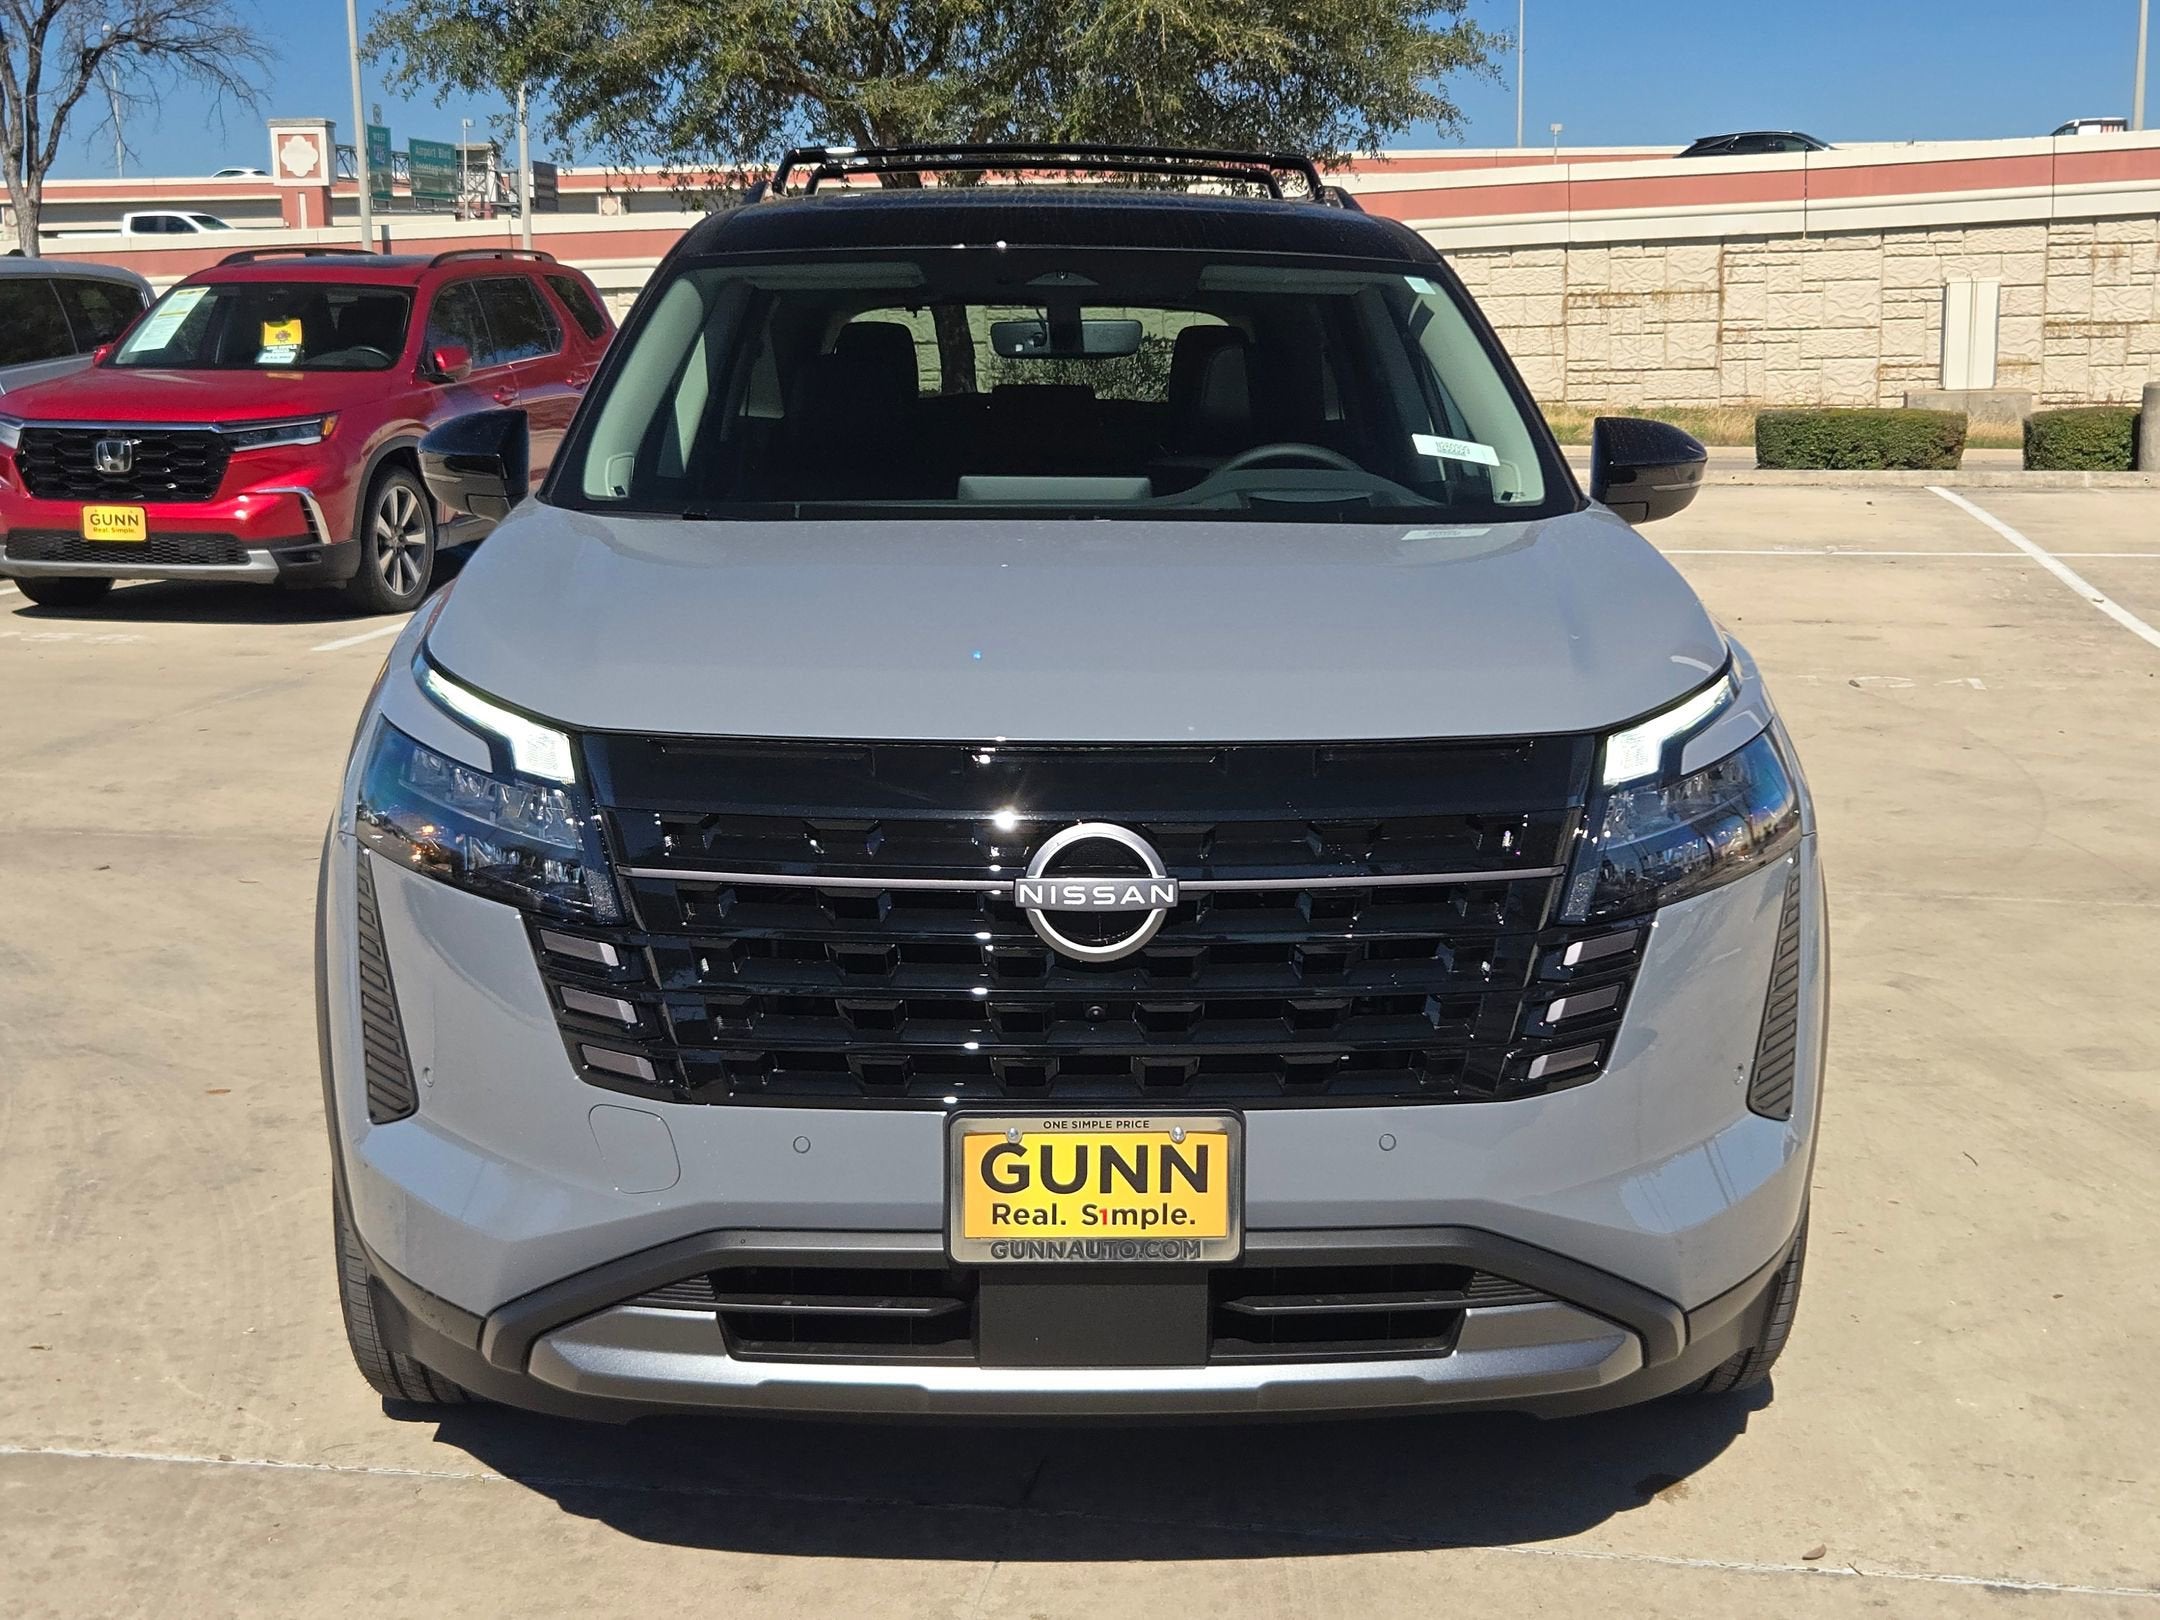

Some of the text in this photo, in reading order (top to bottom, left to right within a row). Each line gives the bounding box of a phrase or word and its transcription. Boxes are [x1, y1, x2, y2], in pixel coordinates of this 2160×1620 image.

[90, 513, 139, 526] GUNN
[1019, 884, 1174, 905] NISSAN
[1043, 1120, 1150, 1129] ONE SIMPLE PRICE
[981, 1143, 1208, 1194] GUNN
[992, 1203, 1067, 1226] Real.
[990, 1240, 1202, 1260] GUNNAUTO.COM
